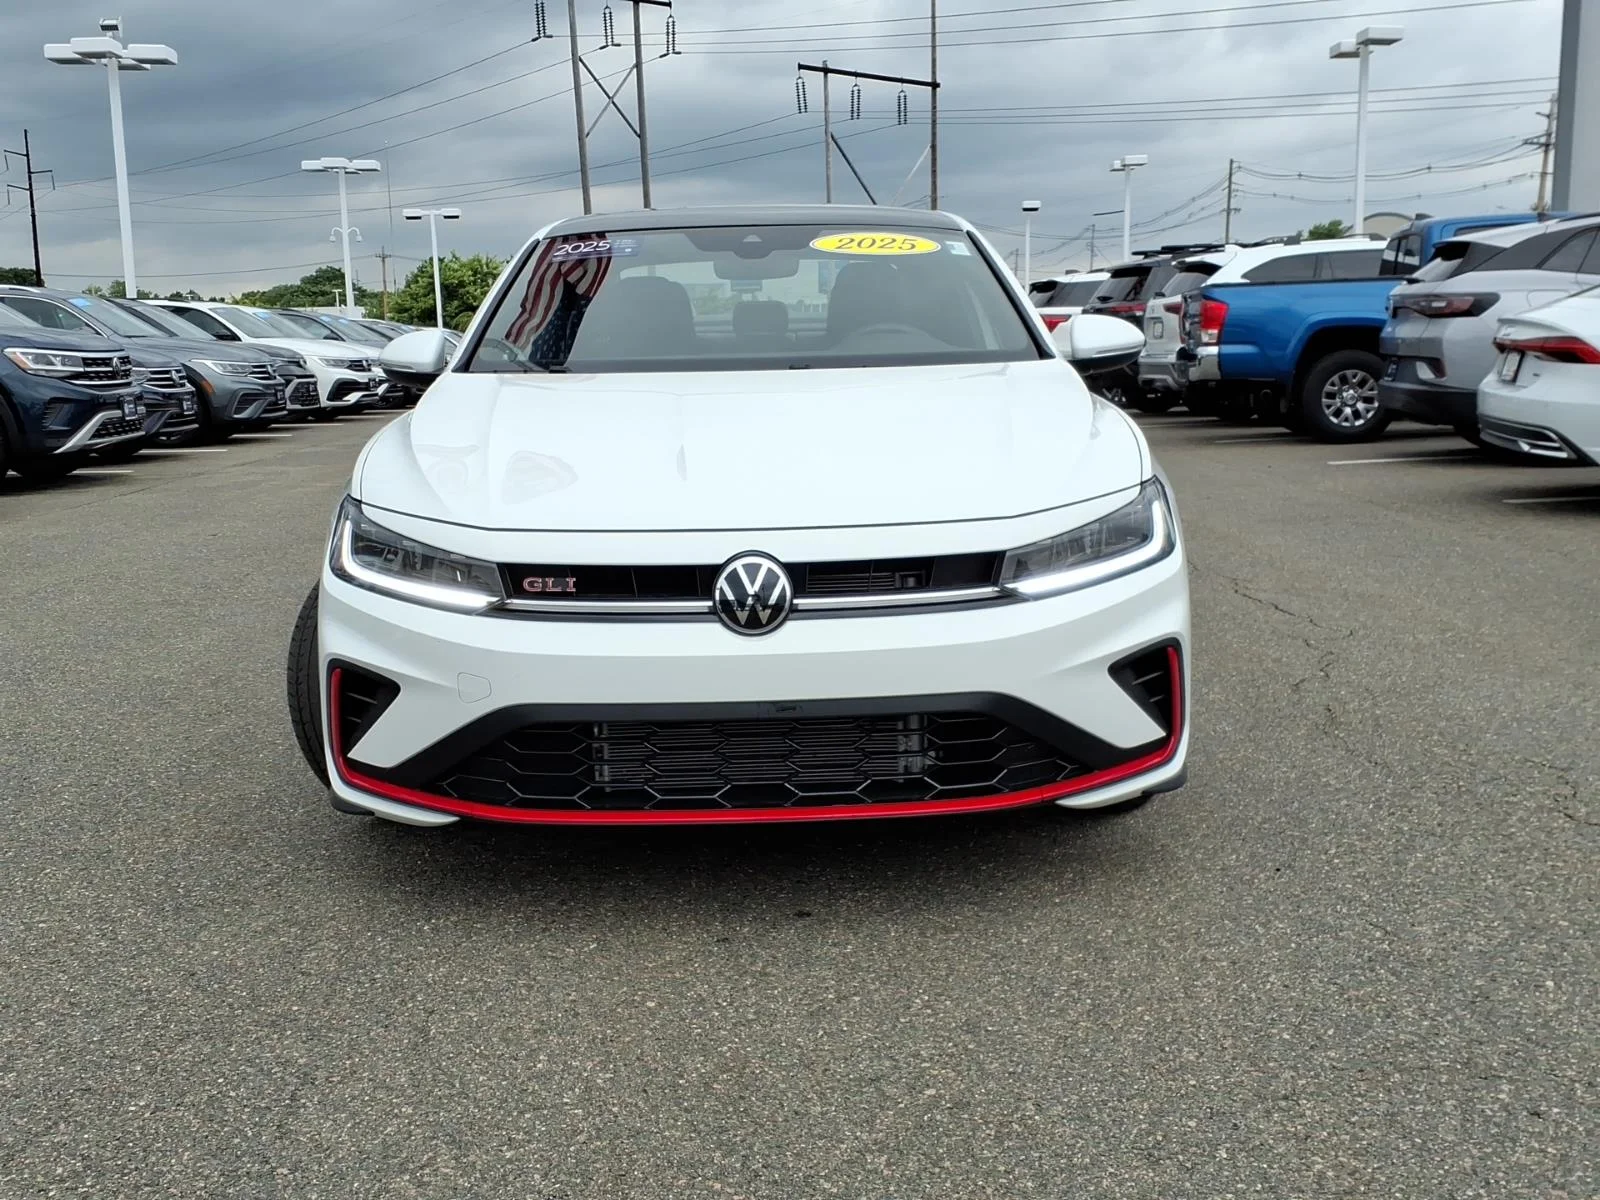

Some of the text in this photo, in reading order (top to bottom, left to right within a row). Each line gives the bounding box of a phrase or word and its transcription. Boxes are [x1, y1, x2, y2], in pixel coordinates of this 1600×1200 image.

[554, 240, 611, 255] 2025
[835, 237, 919, 251] 2025
[523, 576, 577, 592] GLI
